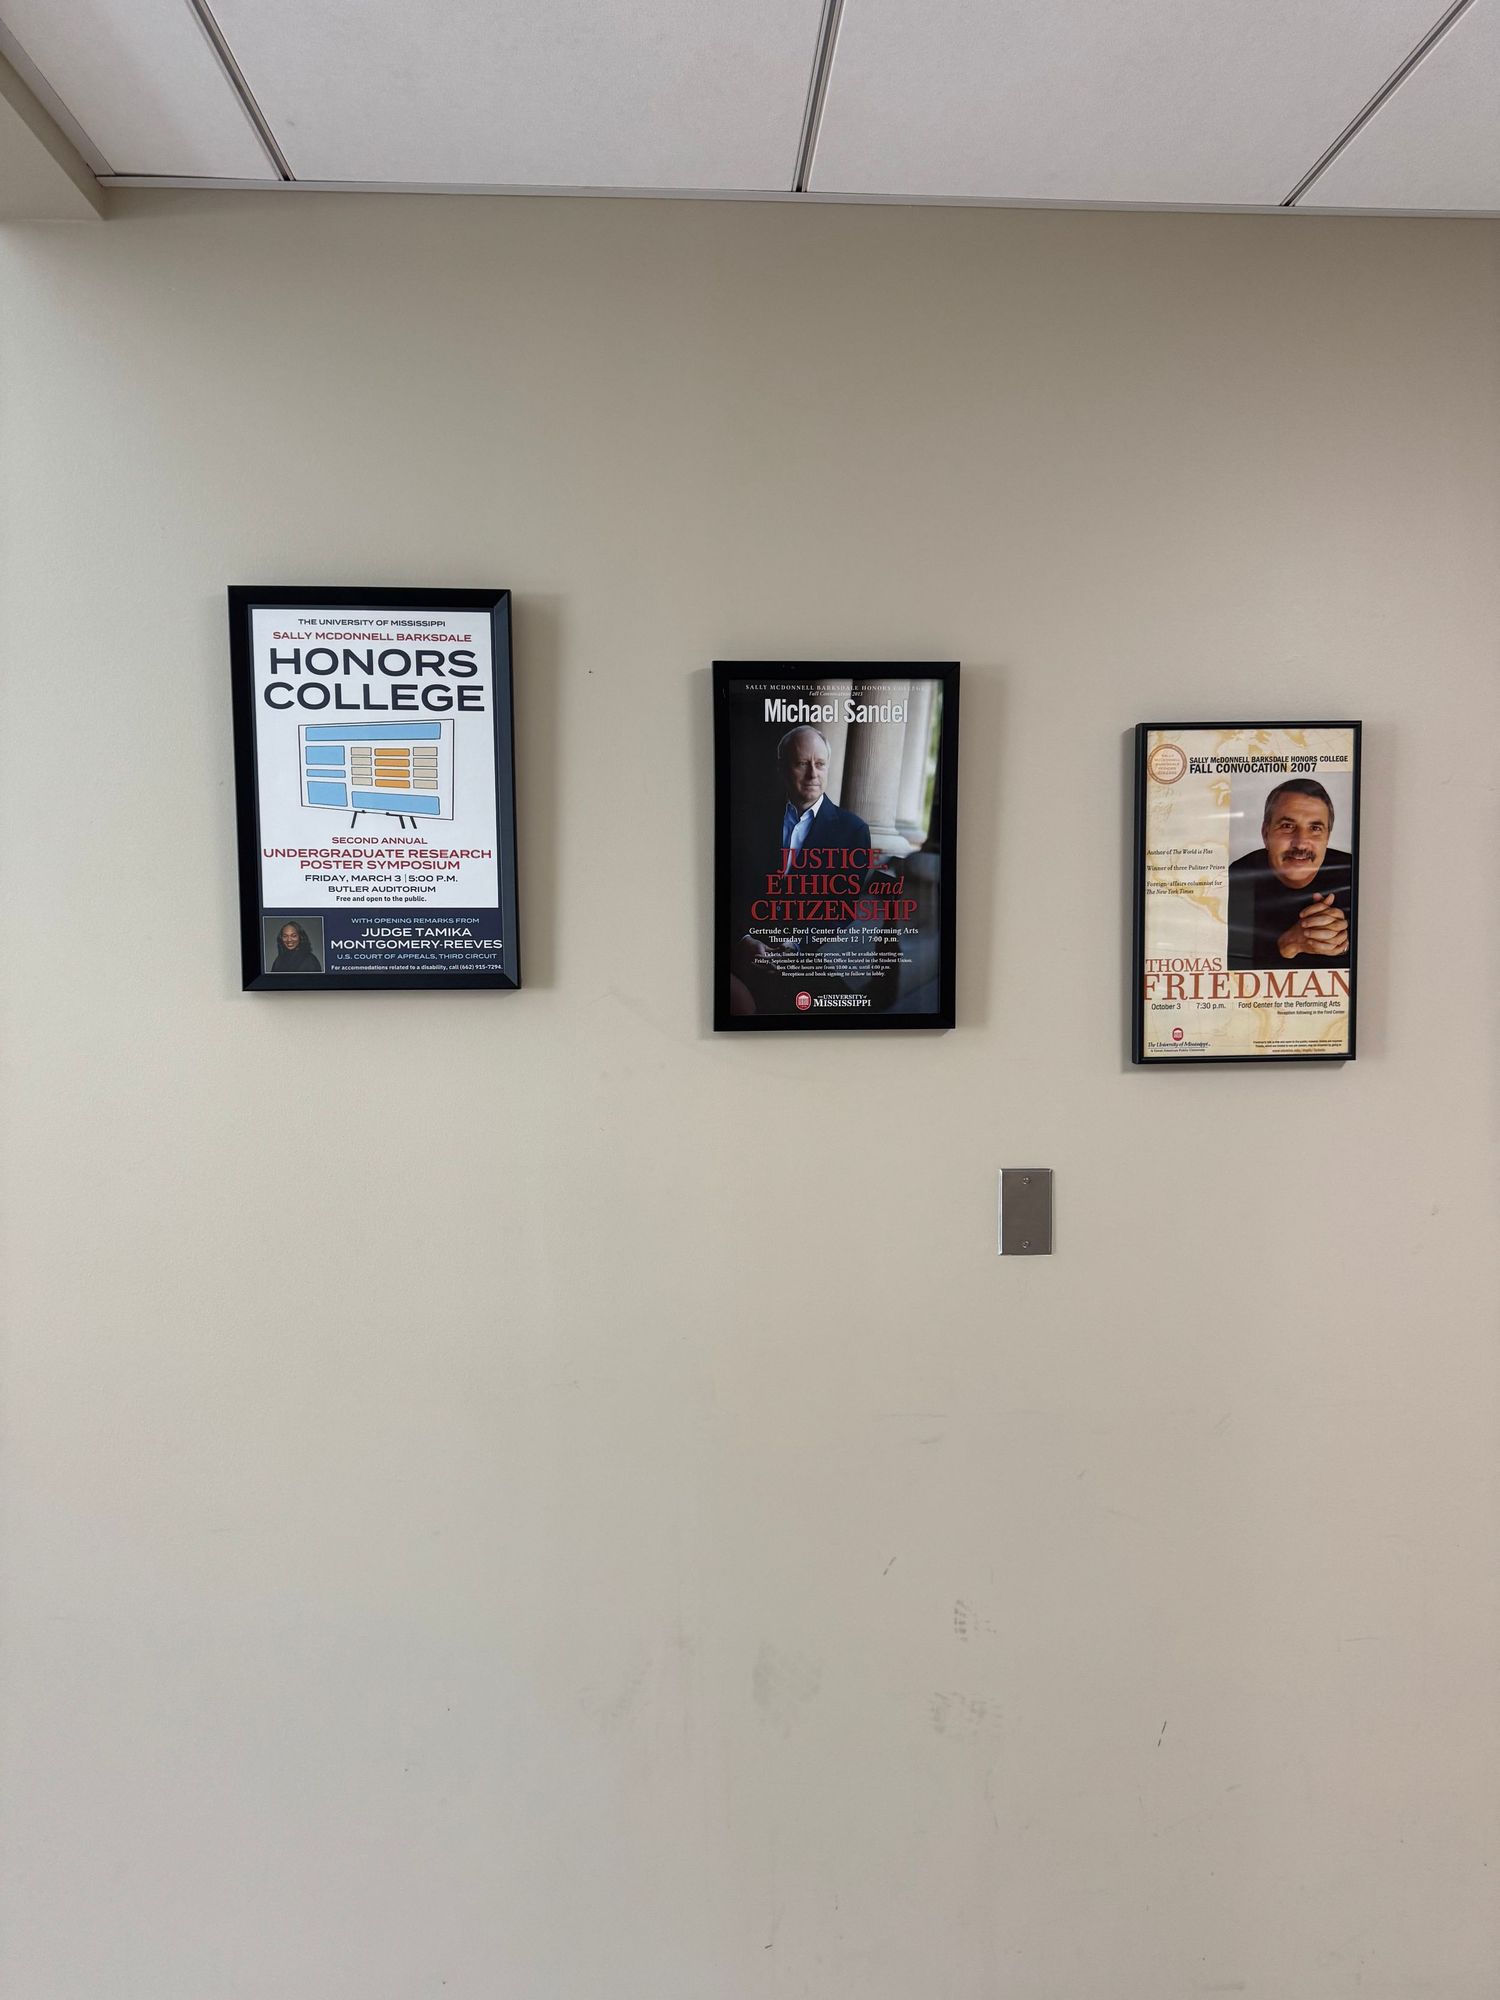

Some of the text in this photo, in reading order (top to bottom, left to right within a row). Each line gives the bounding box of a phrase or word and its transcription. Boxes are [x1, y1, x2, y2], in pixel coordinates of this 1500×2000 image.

[273, 632, 472, 642] SALLY MCDONNELL BARKSDALE
[270, 648, 478, 678] HONORS
[264, 682, 485, 712] COLLEGE
[764, 698, 908, 723] Michael Sandel
[1190, 762, 1317, 774] FALL CONVOCATION 2007
[264, 848, 492, 859] UNDERGRADUATE RESEARCH
[300, 860, 460, 870] POSTER SYMPOSIUM
[777, 848, 888, 874] JUSTICE,
[305, 875, 349, 883] FRIDAY,
[766, 874, 904, 896] ETHICS and
[751, 900, 918, 921] CITIZENSHIP
[362, 928, 472, 937] JUDGE TAMIKA
[862, 928, 902, 936] Performing
[331, 940, 502, 949] MONTGOMERY-REEVES
[769, 936, 802, 944] Thursday
[812, 936, 848, 944] September
[1146, 958, 1222, 972] THOMAS
[1144, 970, 1350, 1001] FRIEDMAN
[1295, 1001, 1327, 1009] Performing
